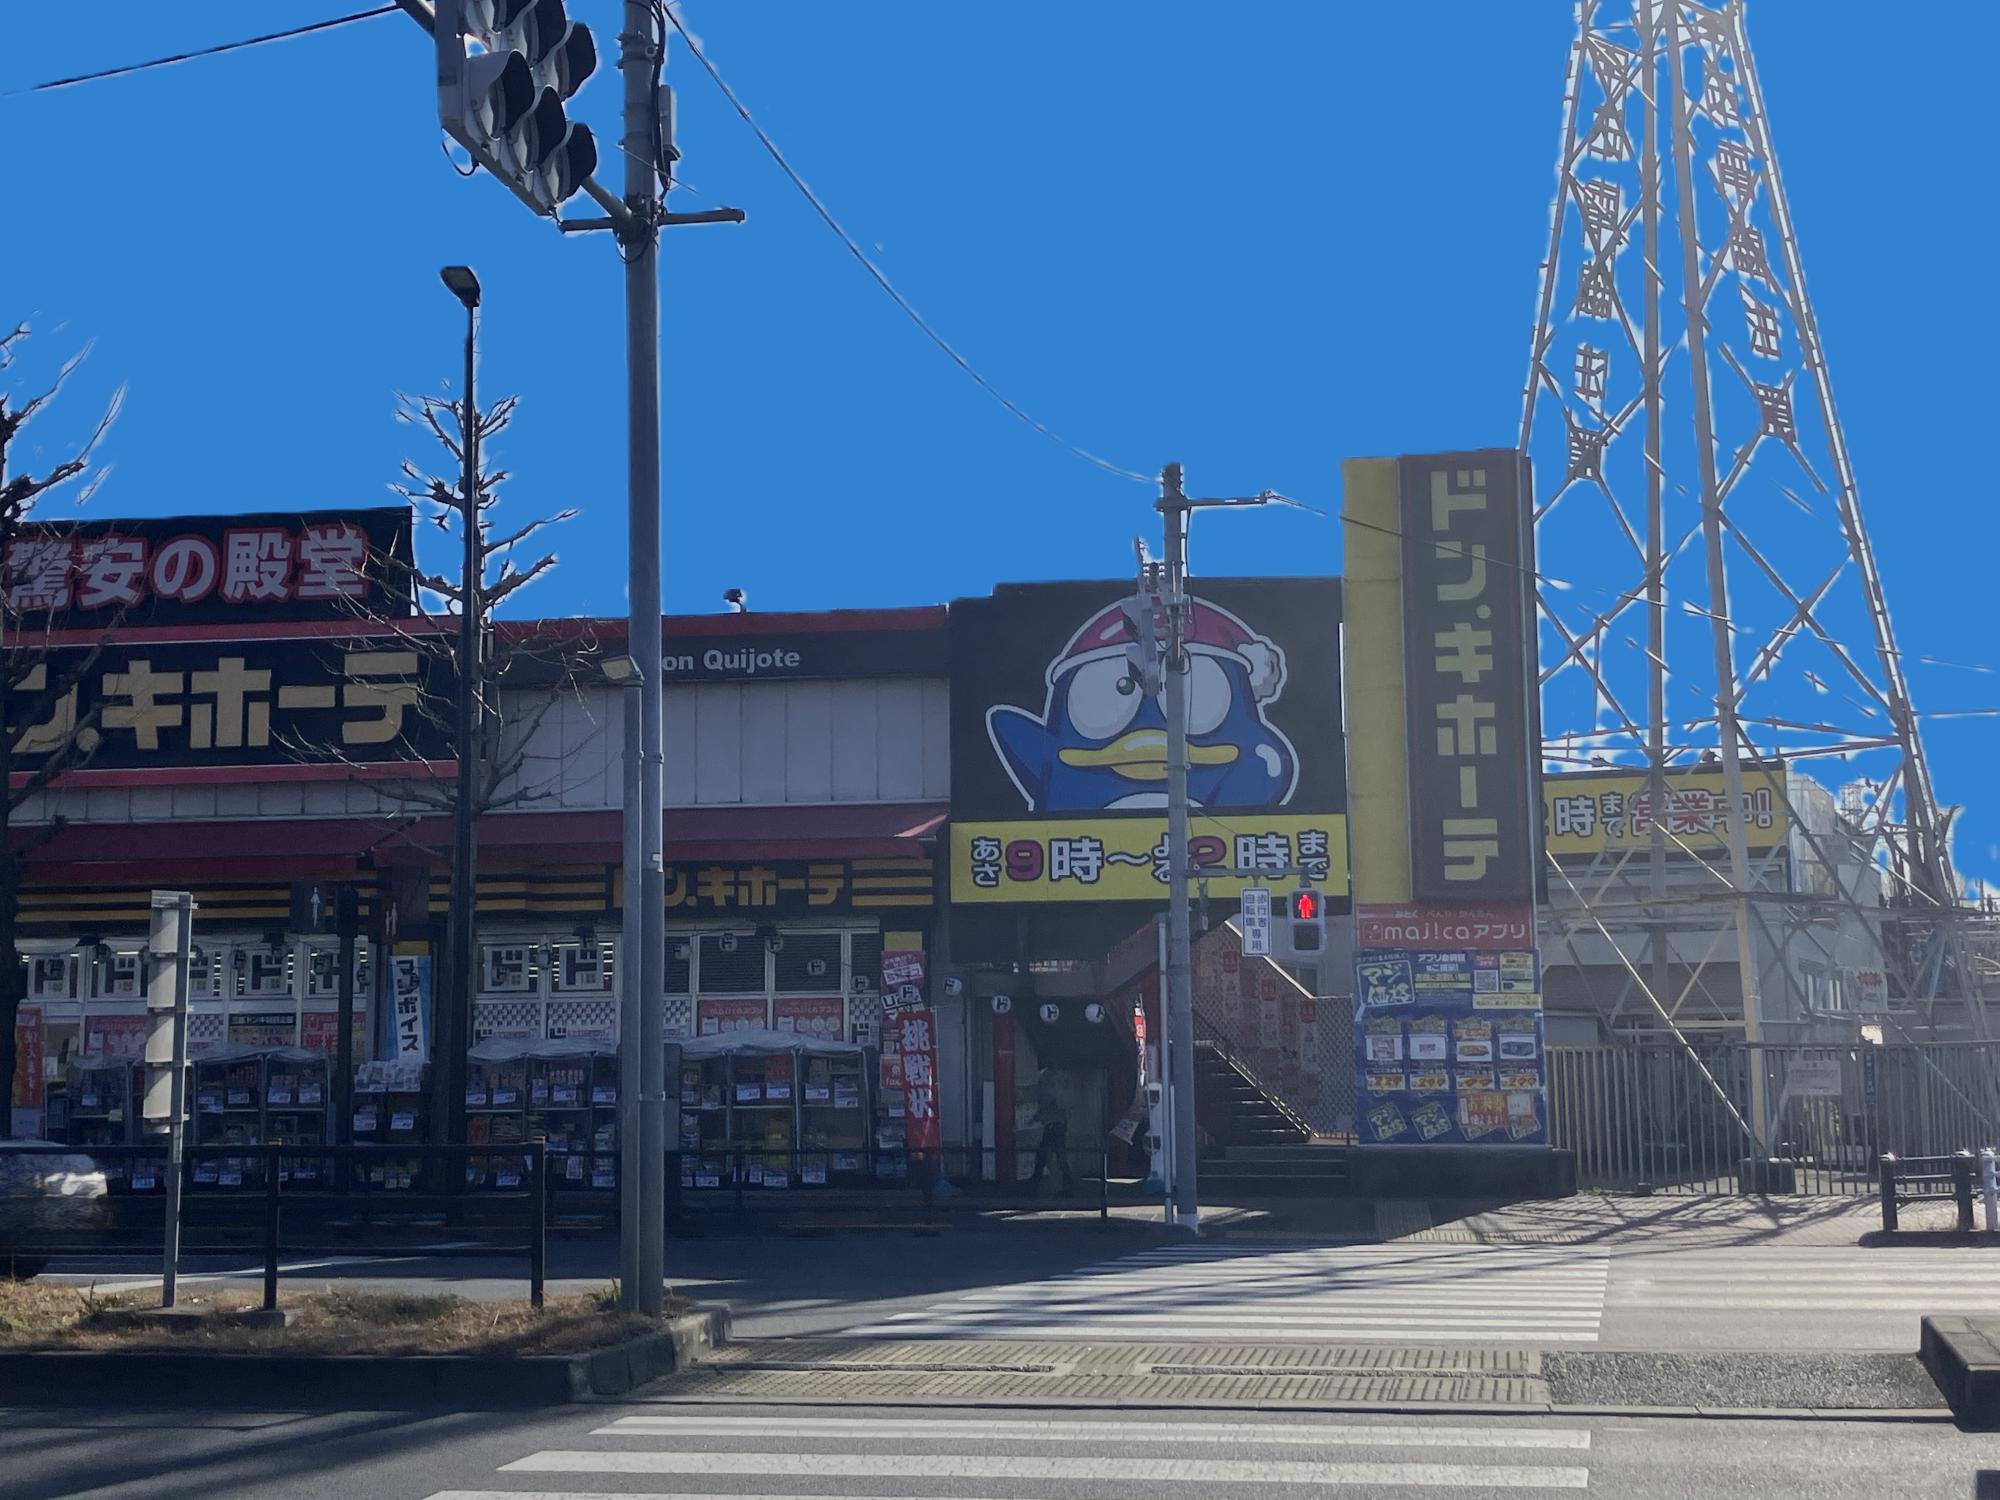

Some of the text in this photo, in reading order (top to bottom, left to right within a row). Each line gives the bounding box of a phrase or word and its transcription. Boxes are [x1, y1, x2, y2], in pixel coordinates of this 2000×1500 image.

[6, 526, 369, 610] 驚安の殿堂
[703, 648, 801, 674] Quijote
[901, 1018, 935, 1119] 挑戦状
